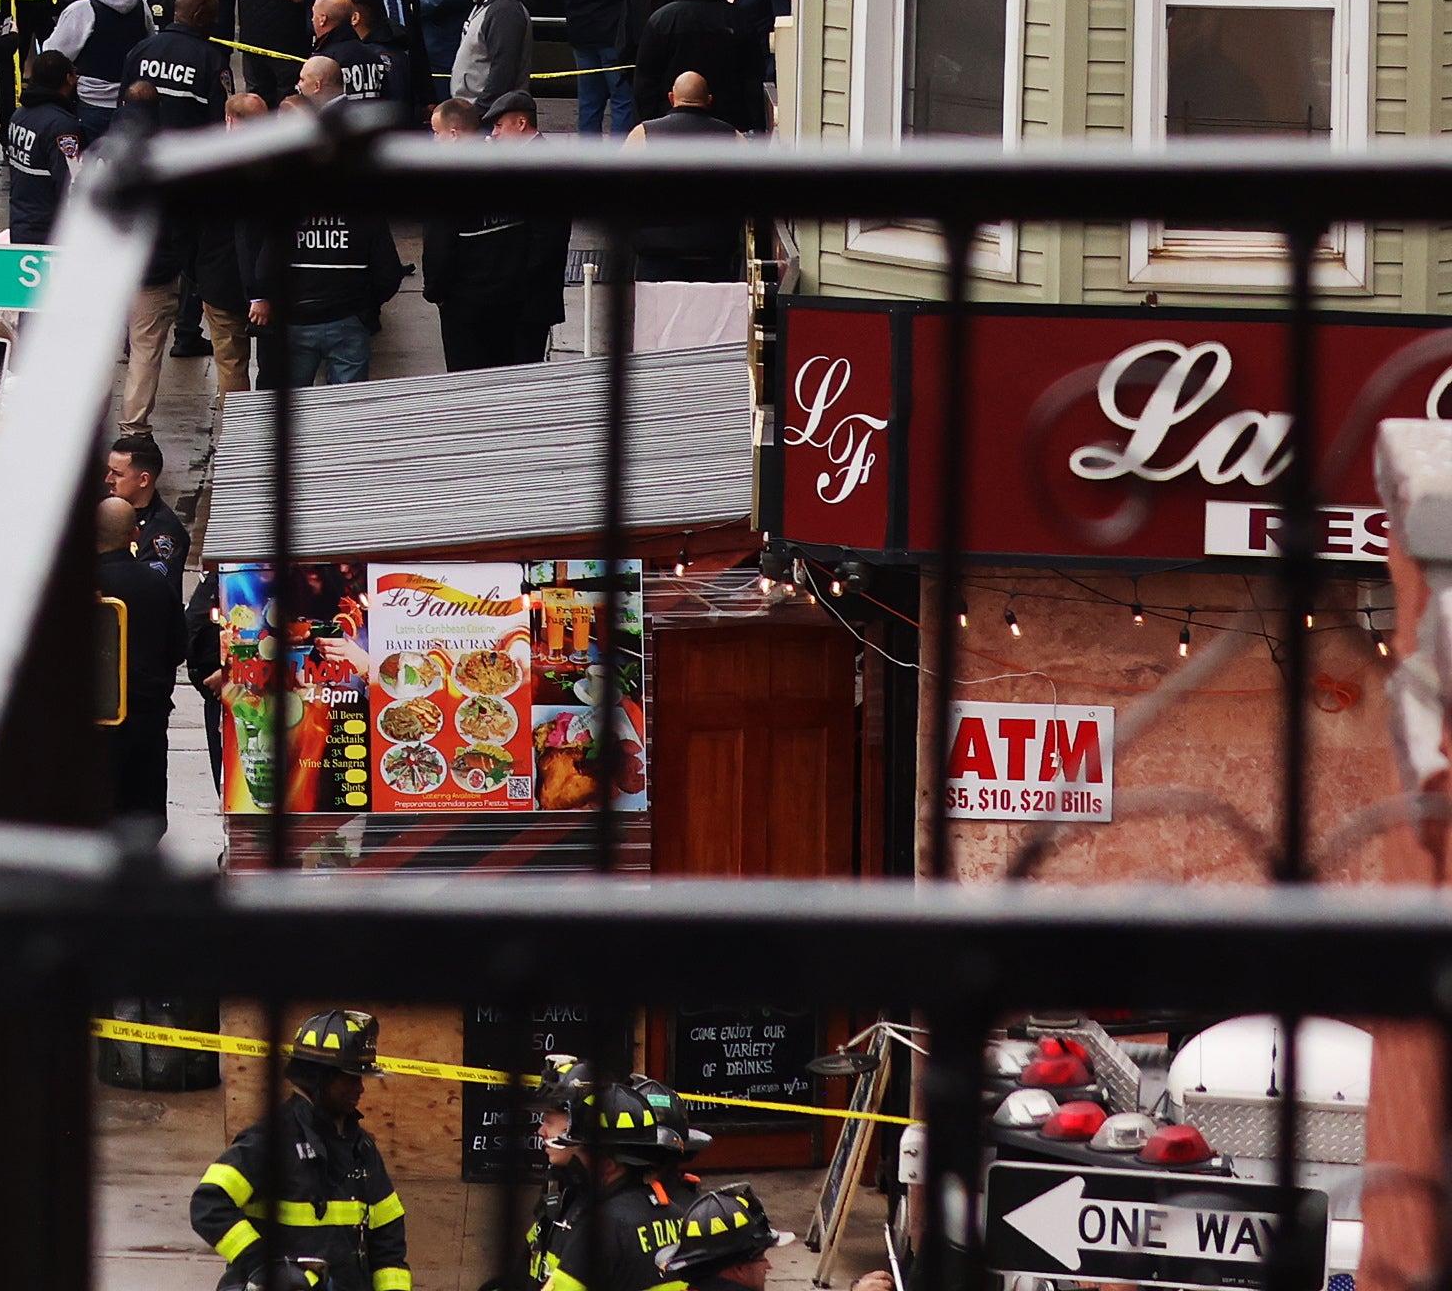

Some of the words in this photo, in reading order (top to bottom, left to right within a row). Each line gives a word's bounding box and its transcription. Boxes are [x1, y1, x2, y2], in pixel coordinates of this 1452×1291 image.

[140, 59, 196, 86] POLICE
[297, 230, 349, 250] POLICE
[381, 587, 411, 609] La
[405, 586, 513, 619] Familia
[386, 638, 412, 651] BAR
[417, 638, 507, 651] RESTAURANT
[303, 686, 359, 708] 4-8pm
[326, 710, 340, 721] All
[341, 710, 365, 721] Beers
[324, 734, 365, 745] Cocktails
[948, 716, 1103, 783] ATM
[298, 758, 323, 770] Wine
[323, 758, 331, 769] &
[332, 758, 366, 772] Sangria
[341, 782, 366, 793] Shots
